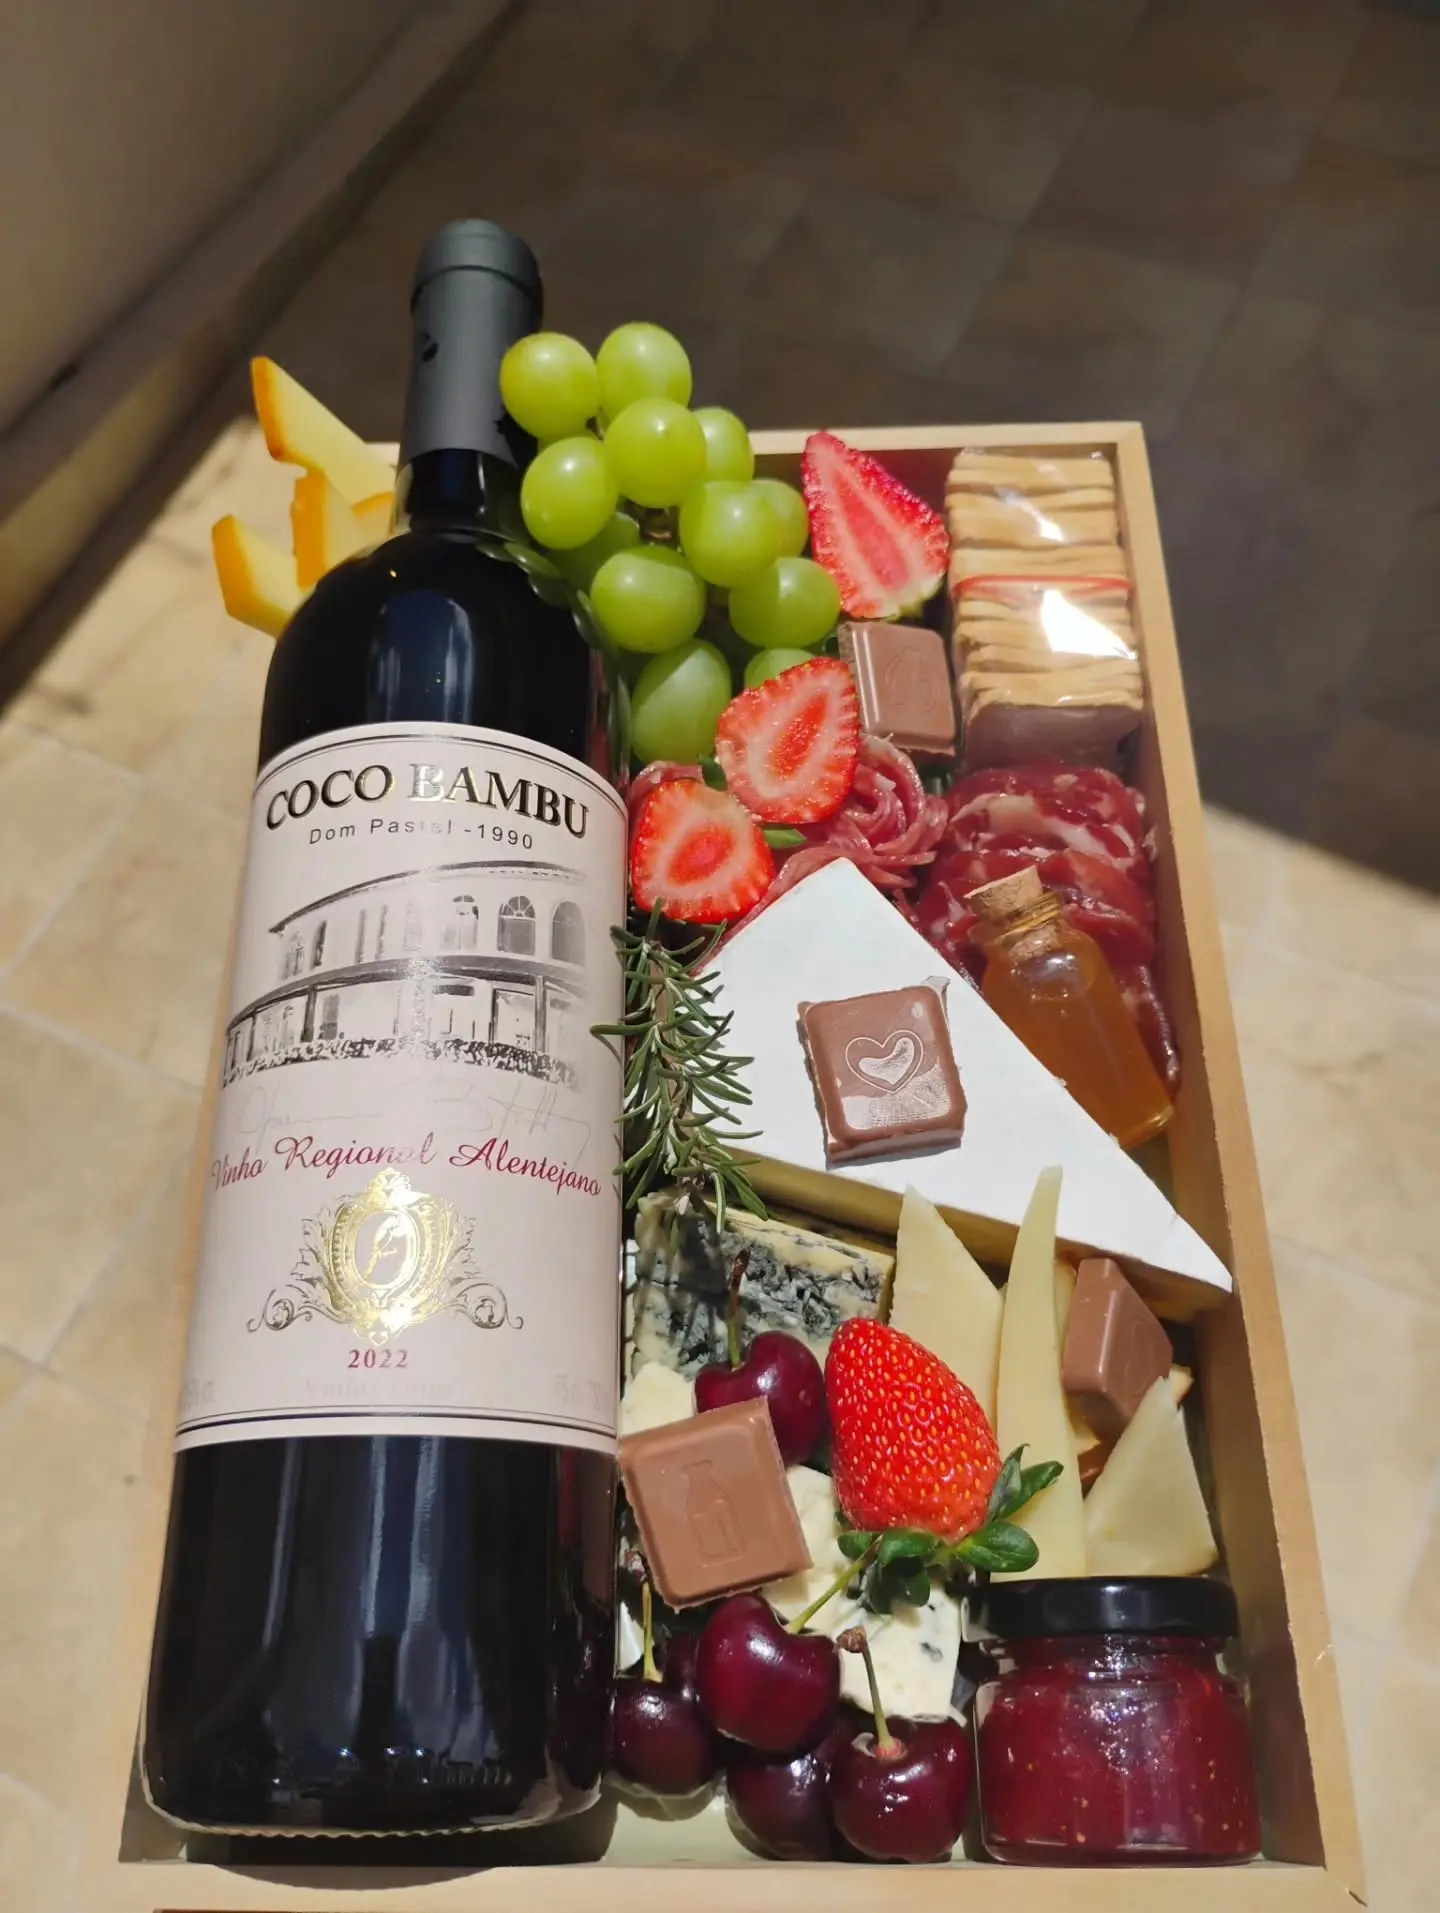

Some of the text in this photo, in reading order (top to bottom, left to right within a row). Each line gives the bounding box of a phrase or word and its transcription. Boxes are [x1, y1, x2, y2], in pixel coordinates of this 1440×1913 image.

[266, 763, 589, 839] COCO BAMBU
[308, 825, 356, 845] Dom
[212, 1131, 601, 1196] Vinho Regional Alentejano
[347, 1348, 409, 1369] 2022
